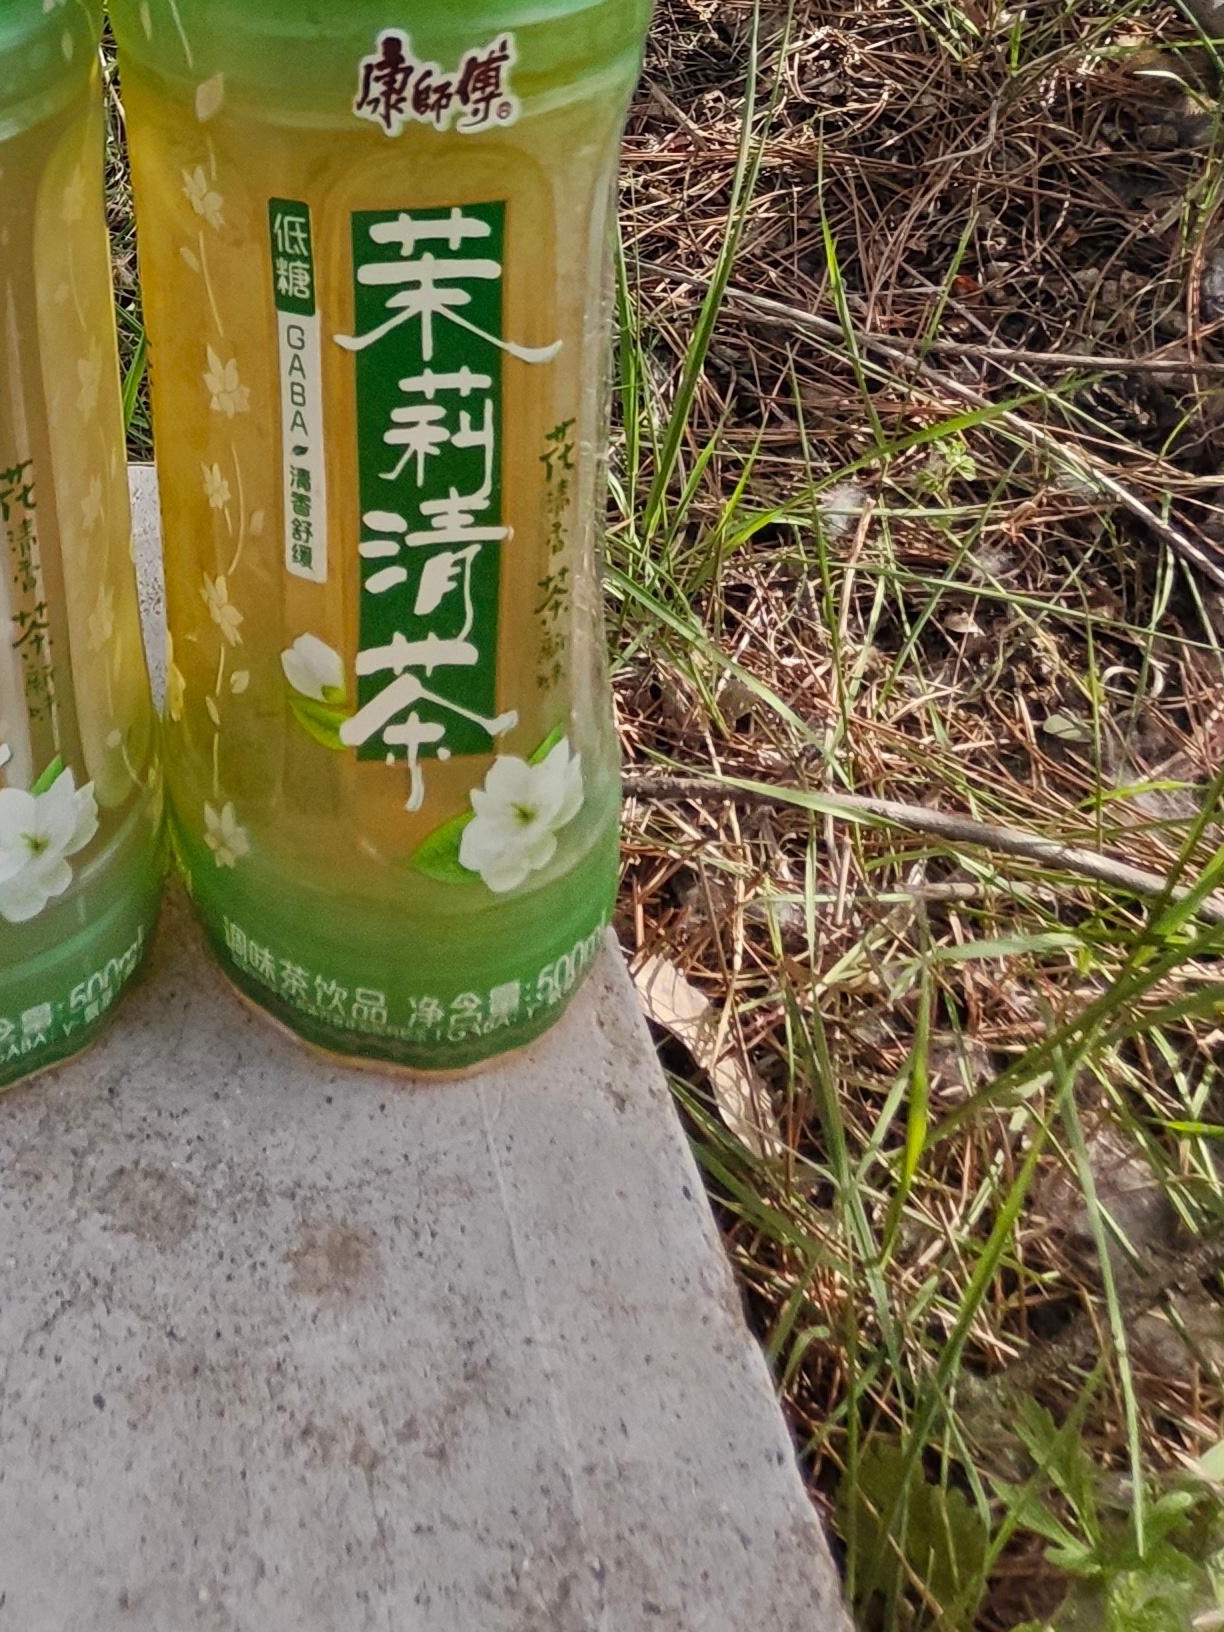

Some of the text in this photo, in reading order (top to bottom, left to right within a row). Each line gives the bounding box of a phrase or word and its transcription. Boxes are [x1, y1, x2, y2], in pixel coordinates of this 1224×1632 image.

[274, 215, 312, 299] 低糖
[287, 324, 309, 437] GABA
[333, 207, 564, 813] 茉莉清茶
[222, 914, 388, 1025] 调味茶饮品
